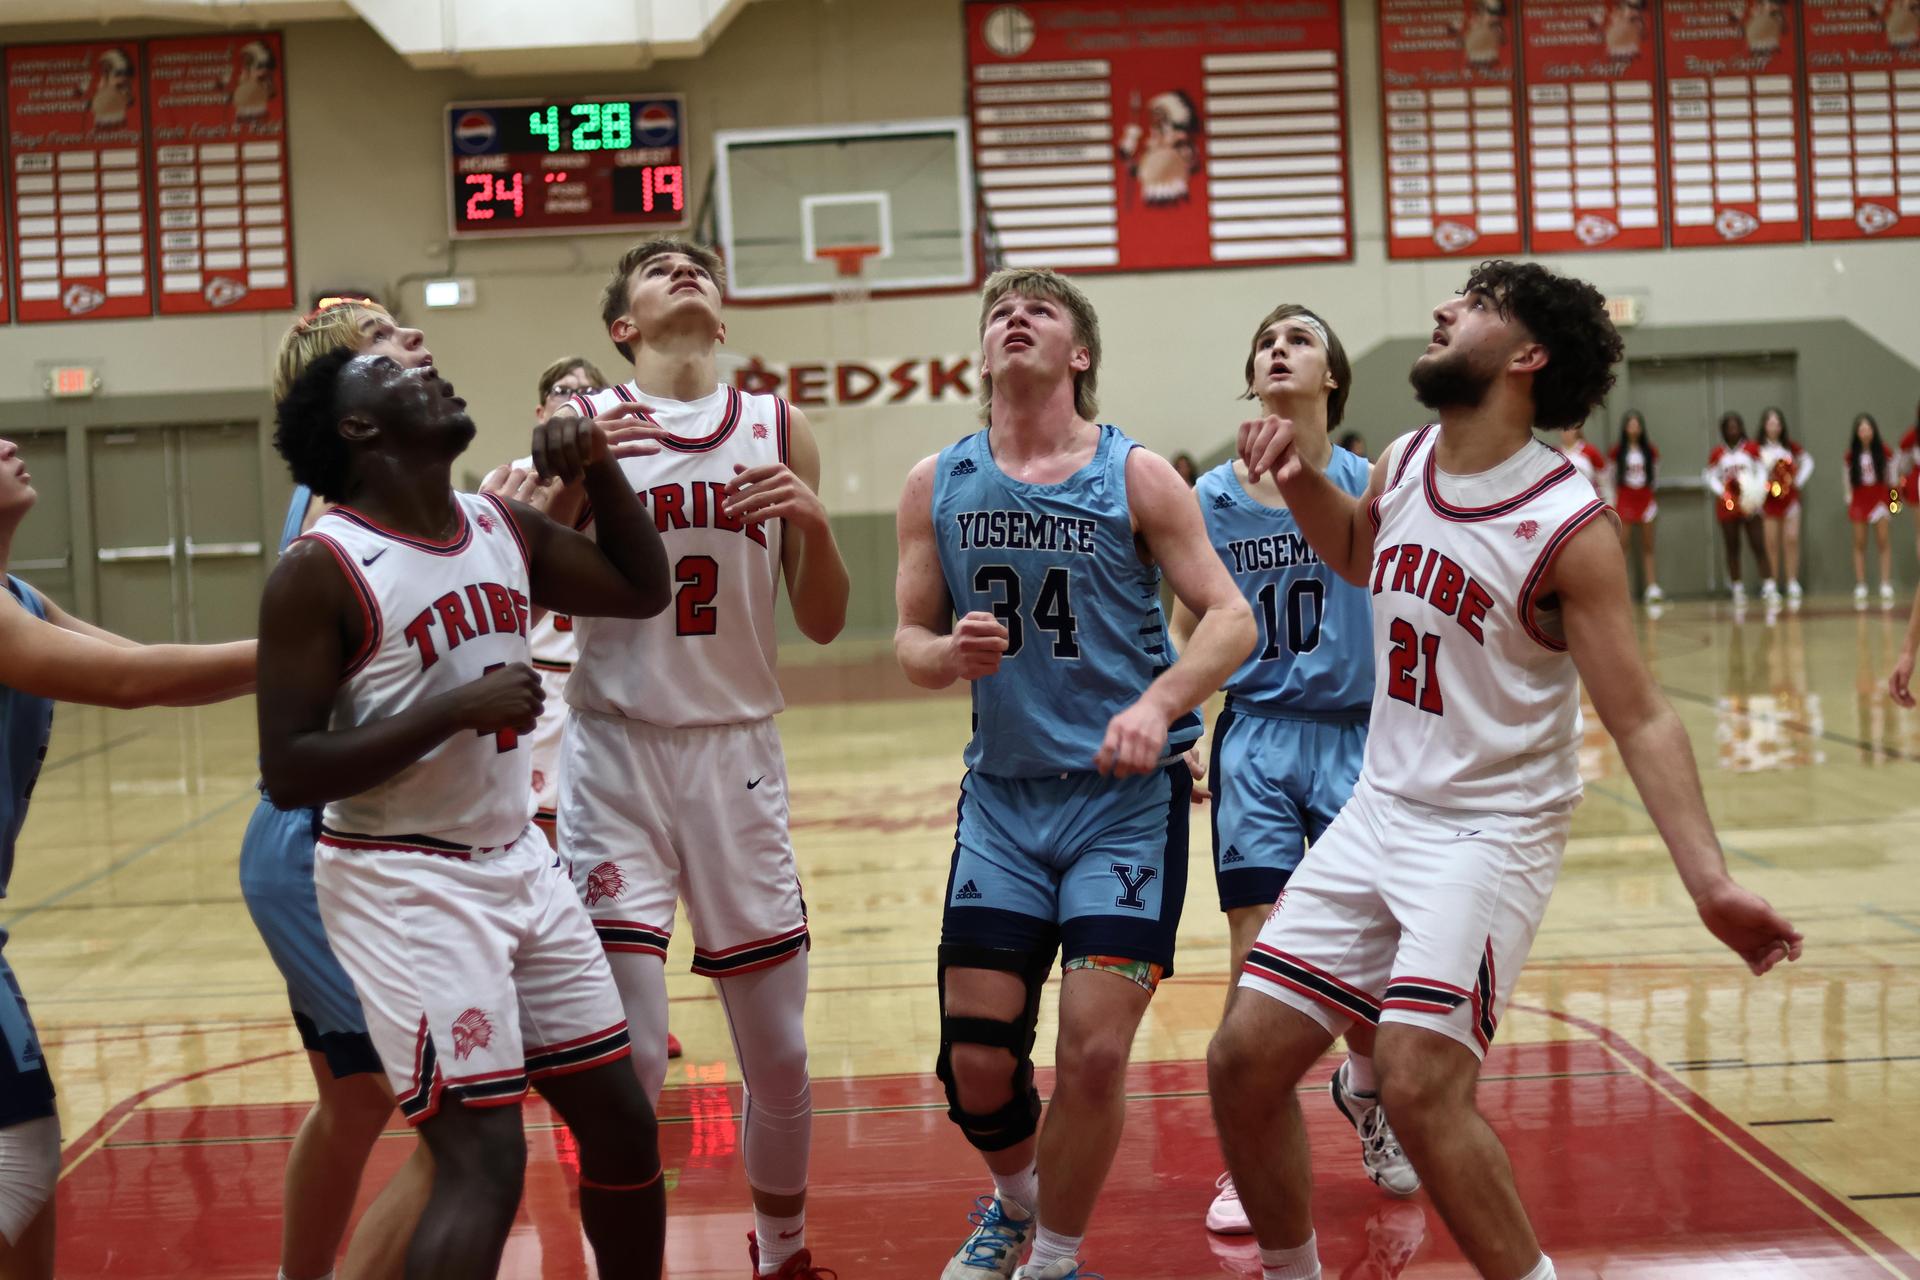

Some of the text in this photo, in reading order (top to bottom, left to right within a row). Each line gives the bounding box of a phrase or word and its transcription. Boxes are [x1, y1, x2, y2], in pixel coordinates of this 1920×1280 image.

[466, 172, 523, 219] 24
[642, 166, 683, 212] 19
[735, 355, 972, 405] REDSK
[956, 510, 1097, 556] YOSEMITE
[675, 555, 719, 636] 2
[973, 564, 1080, 660] 34
[1257, 578, 1326, 662] 10
[1373, 544, 1495, 647] TRIBE
[1388, 617, 1443, 717] 21
[1111, 863, 1157, 910] Y
